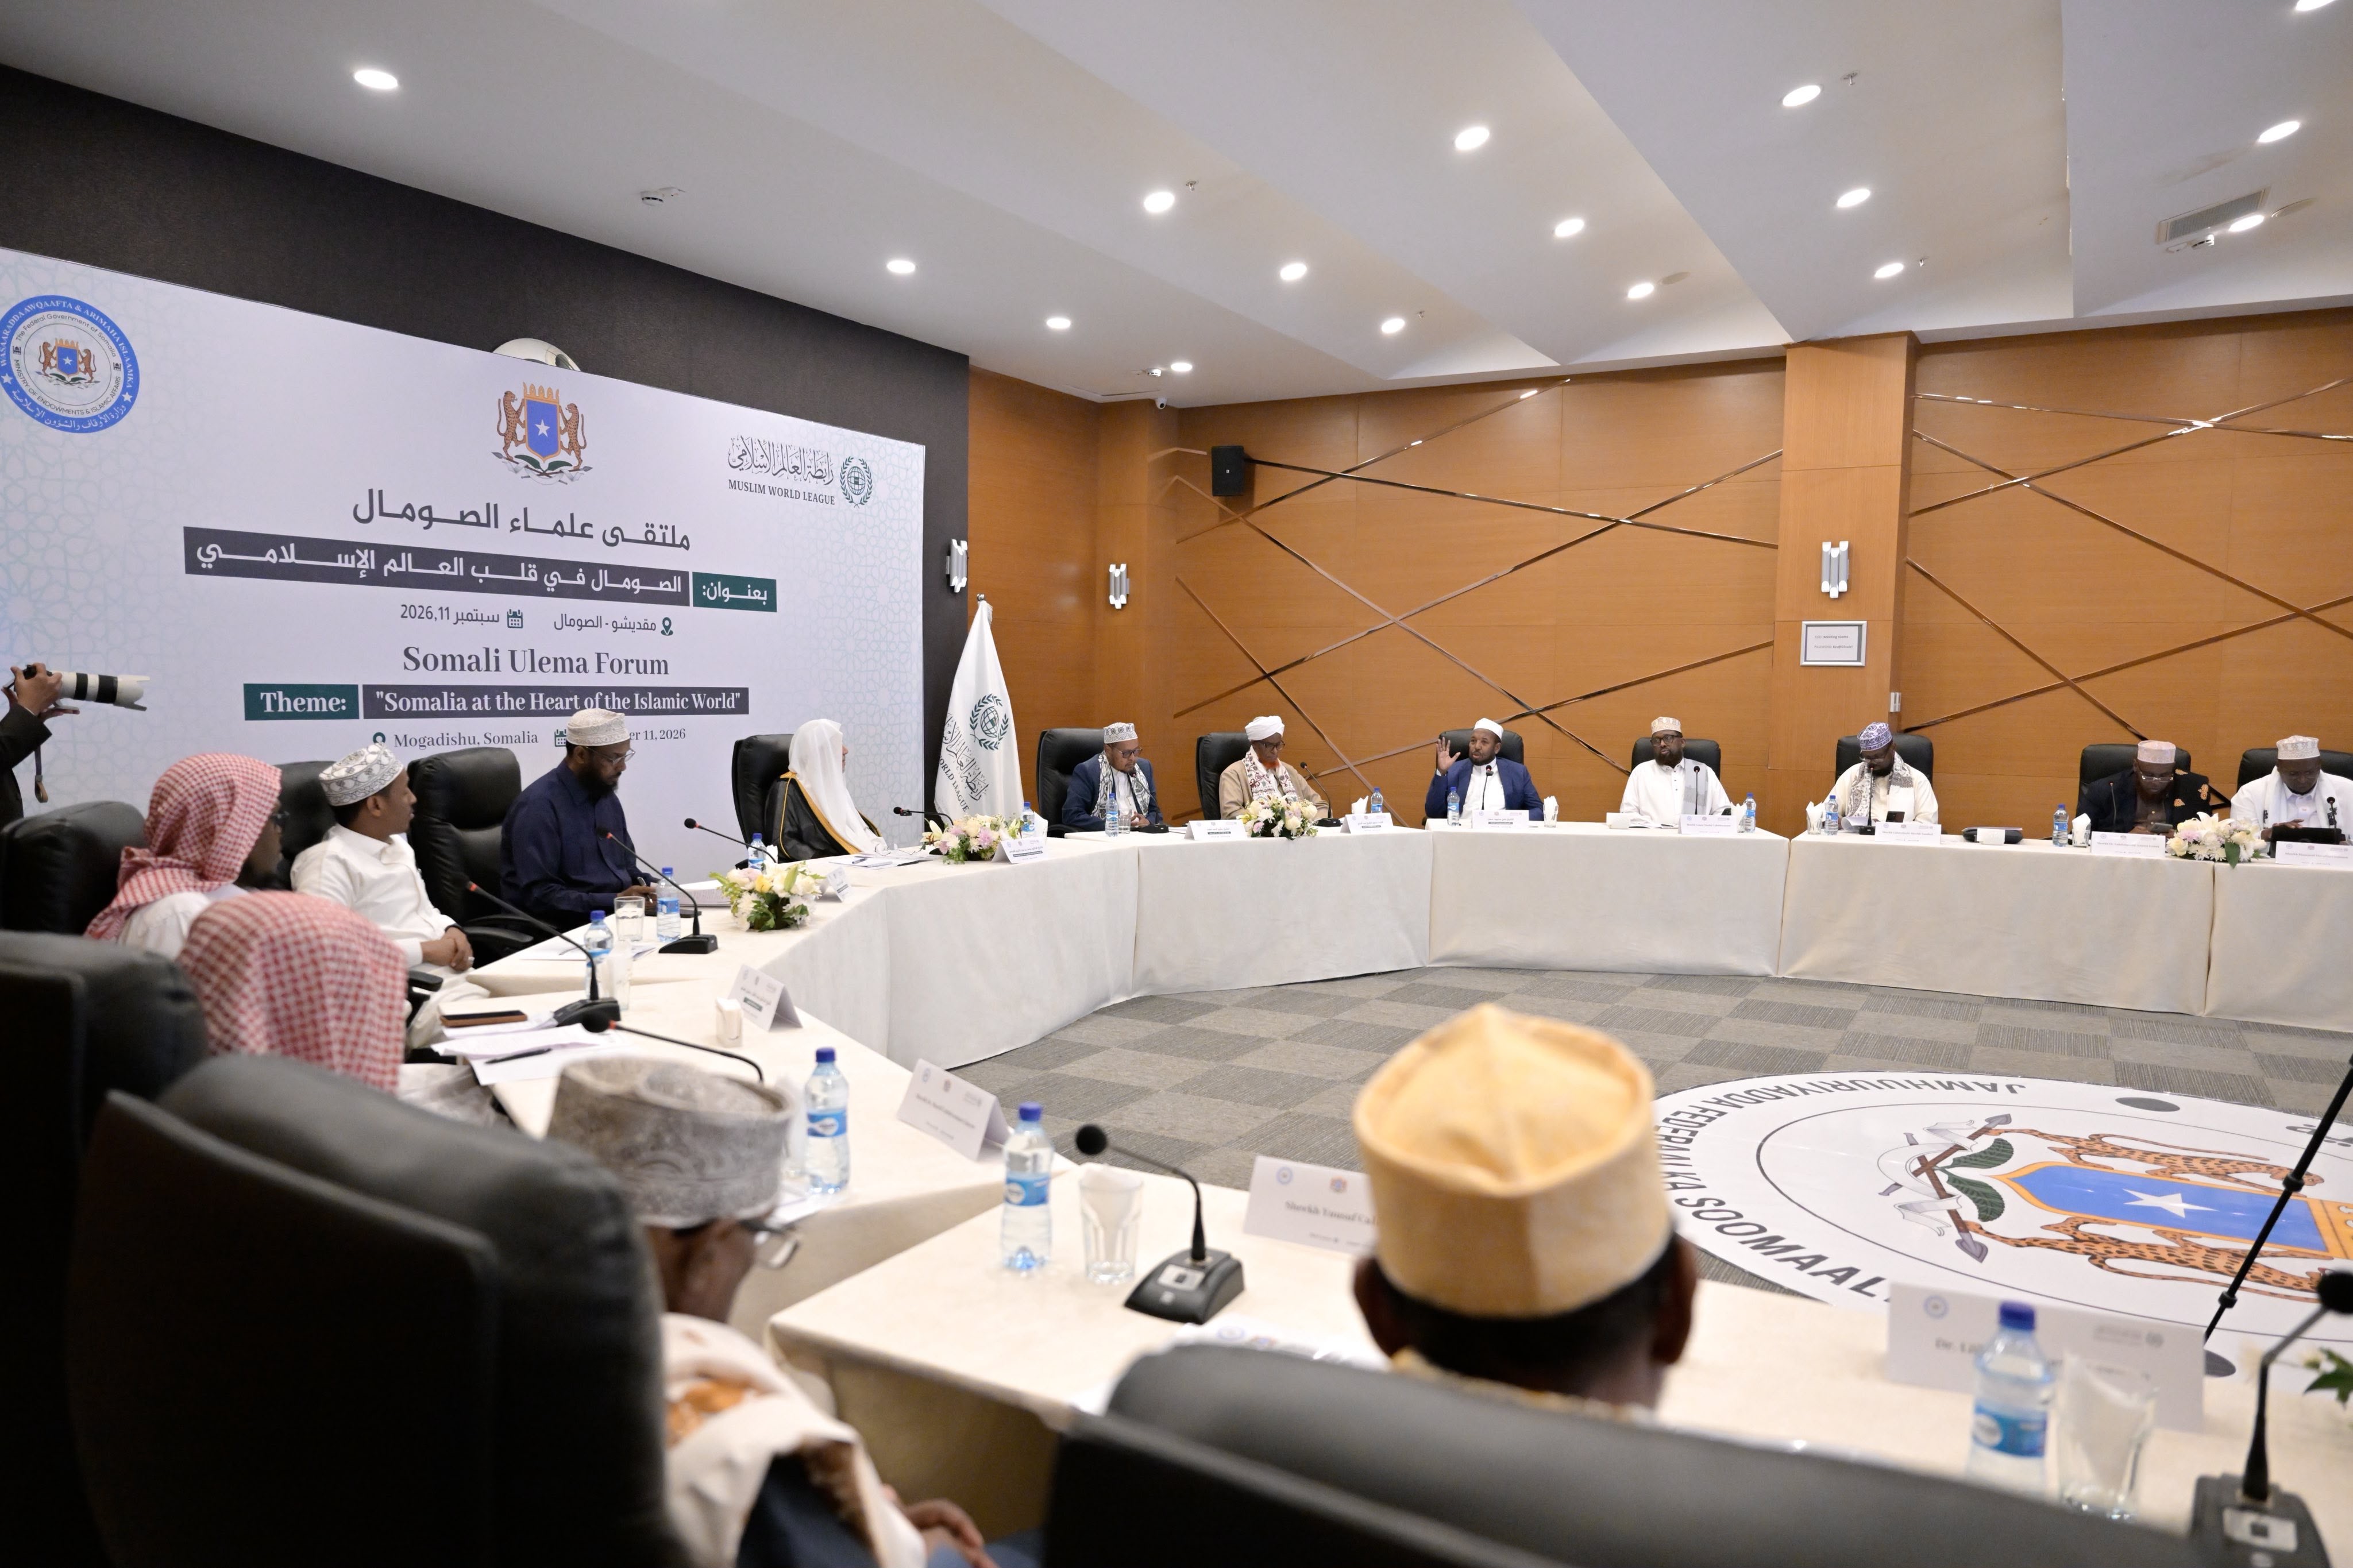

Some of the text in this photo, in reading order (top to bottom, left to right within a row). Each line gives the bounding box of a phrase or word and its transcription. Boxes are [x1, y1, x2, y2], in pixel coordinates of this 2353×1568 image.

[24, 300, 73, 314] AWQAAFTA
[16, 330, 25, 341] The
[23, 315, 46, 331] Federal
[47, 314, 90, 327] Government
[98, 332, 116, 357] Somalia
[14, 360, 30, 387] MINISTRY
[29, 388, 38, 396] OF
[37, 396, 84, 415] ENDOWMENTS
[90, 397, 111, 413] ISLAMIC
[110, 376, 121, 399] AFFAIRS
[728, 479, 835, 505] MUSLIM WORLD LEAGUE
[353, 488, 691, 551] ملتقى علماء الصومال
[197, 543, 767, 605] بعنوان: الصومال في قلب العالم الإسلامي
[453, 609, 500, 625] سبتمبر
[554, 614, 602, 630] الصومال
[612, 618, 657, 632] مقديشو
[403, 646, 669, 675] Somali Ulema Forum
[260, 691, 346, 712] Theme:
[376, 690, 740, 712] "Somalia at the Heart of the Islamic World"
[394, 731, 539, 750] Mogadishu, Somalia
[643, 730, 657, 741] 11,
[659, 728, 686, 740] 2026
[940, 756, 955, 781] ORLD
[952, 781, 970, 812] LEAGUE
[1700, 1079, 2026, 1109] JAMHUURIYADDA
[1674, 1197, 1890, 1302] SOOMAAL
